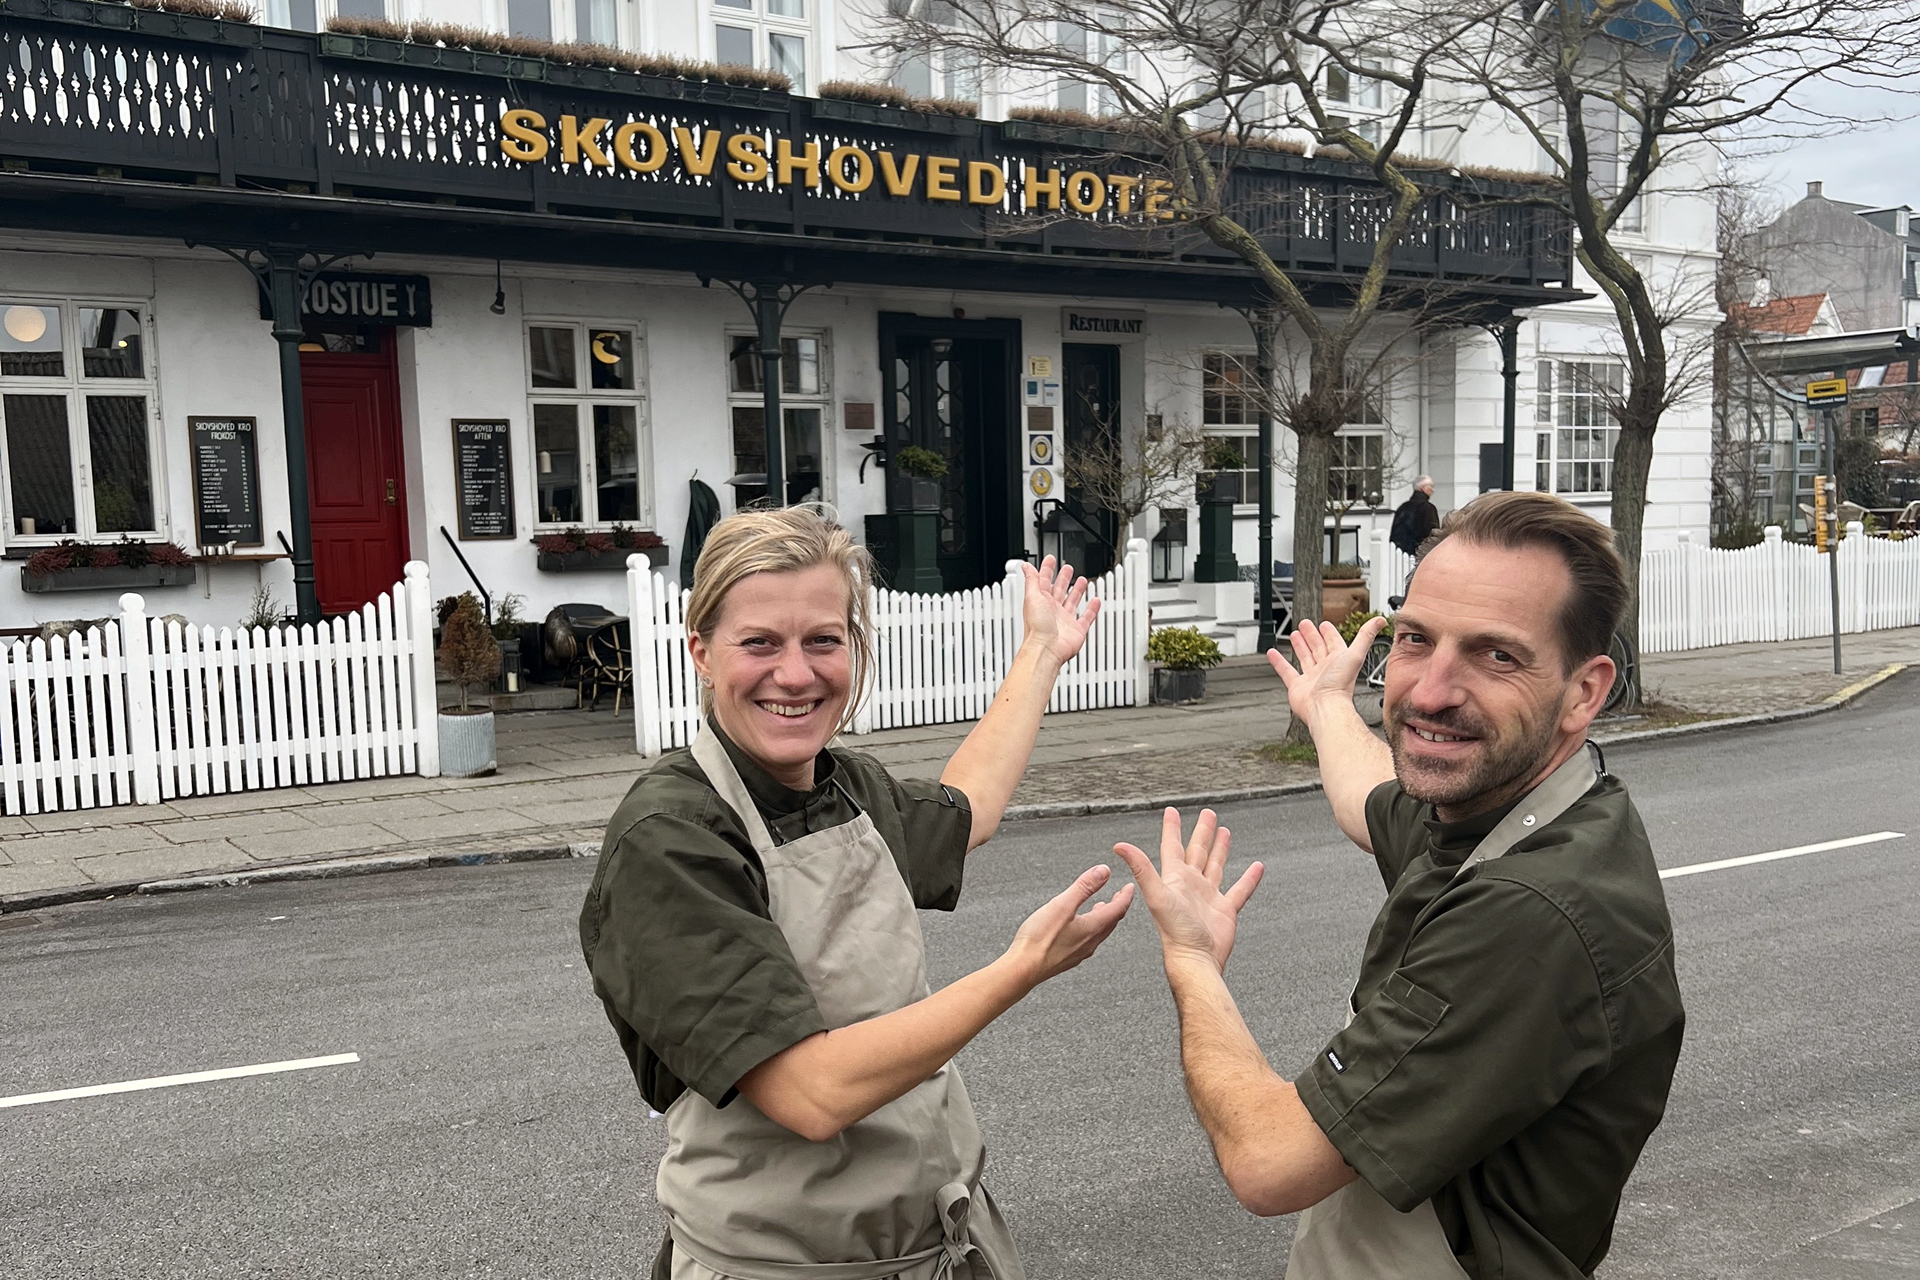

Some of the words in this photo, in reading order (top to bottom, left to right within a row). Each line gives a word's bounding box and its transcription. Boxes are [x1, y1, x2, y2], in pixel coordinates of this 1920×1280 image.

[500, 108, 1006, 205] SKOVSHOVED
[195, 422, 235, 431] SKOVSHOVED
[237, 422, 252, 431] KRO
[458, 424, 494, 433] SKOVSHOVED
[495, 424, 507, 433] KRO
[210, 431, 237, 441] FROKOST
[474, 432, 492, 441] AFTEN
